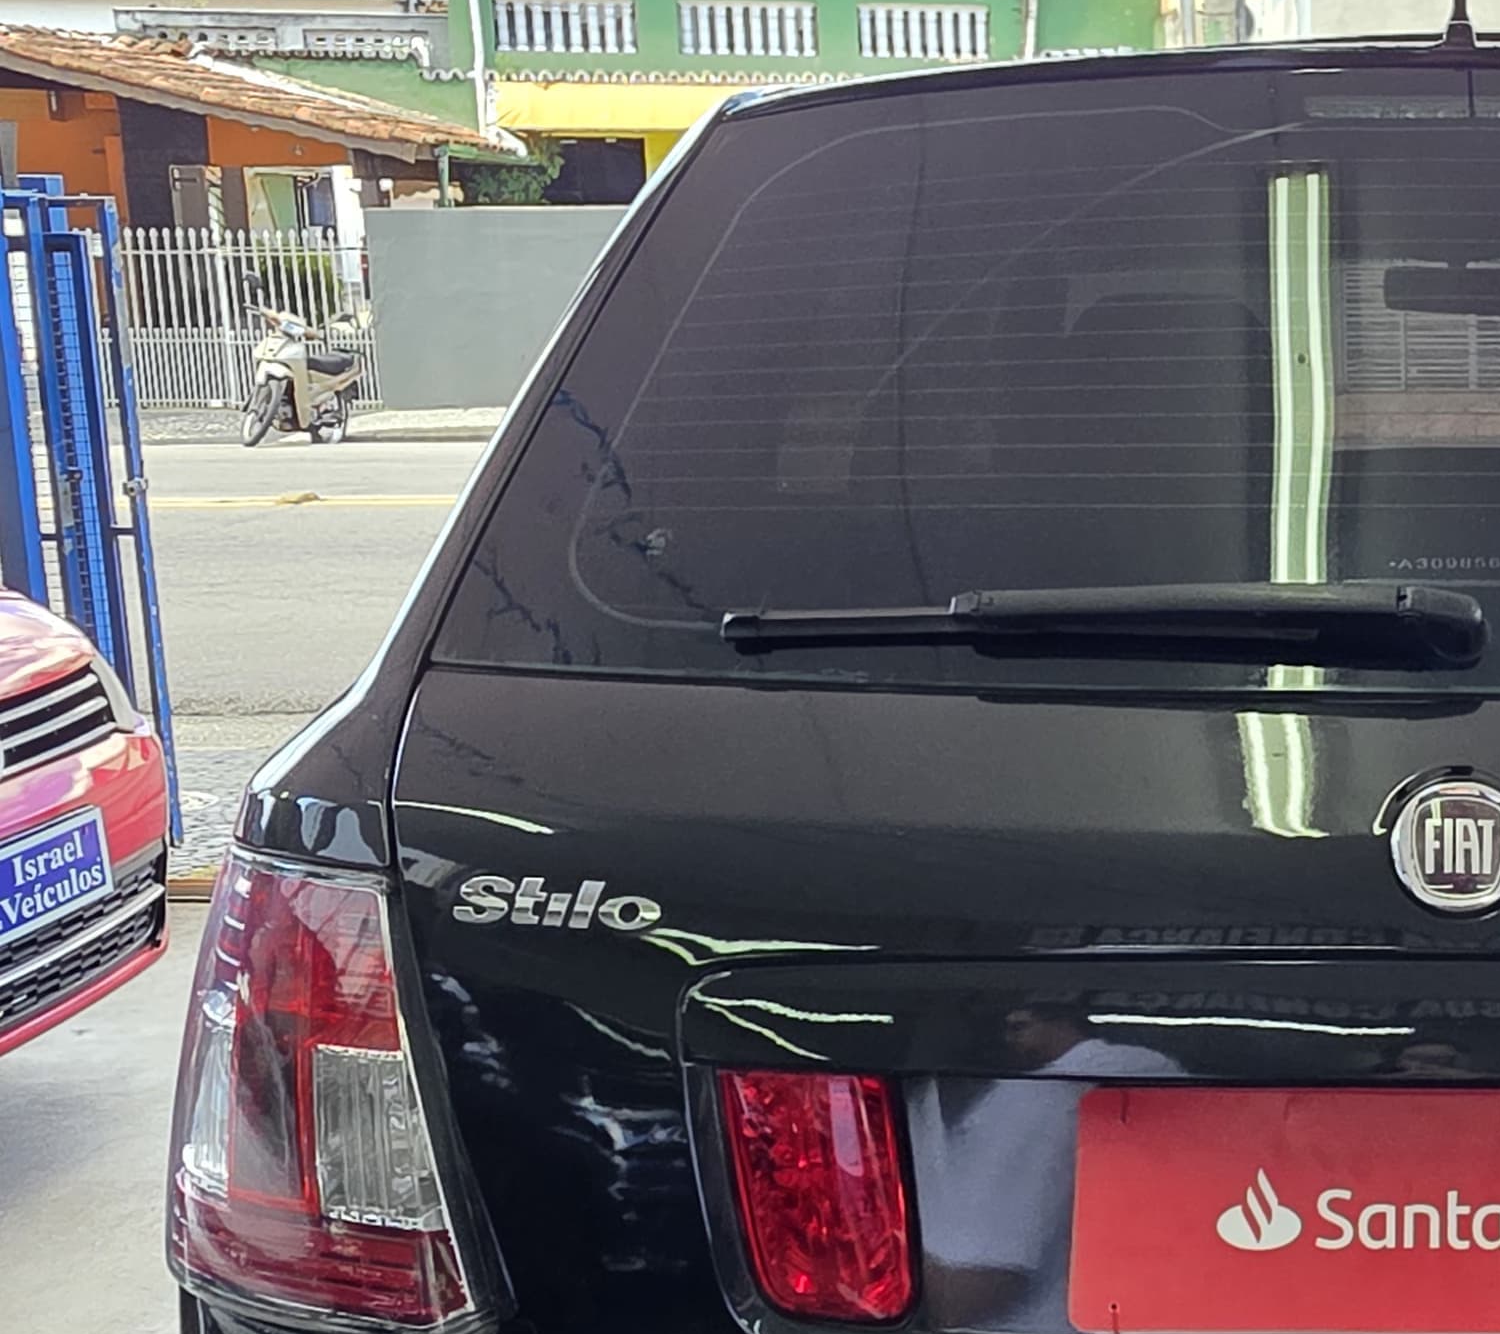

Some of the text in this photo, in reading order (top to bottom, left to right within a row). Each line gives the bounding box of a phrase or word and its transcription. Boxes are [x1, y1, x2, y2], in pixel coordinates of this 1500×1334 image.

[12, 829, 84, 887] Israel
[1425, 818, 1496, 875] FIAT
[0, 863, 104, 926] Veículos
[453, 874, 662, 931] Stilo
